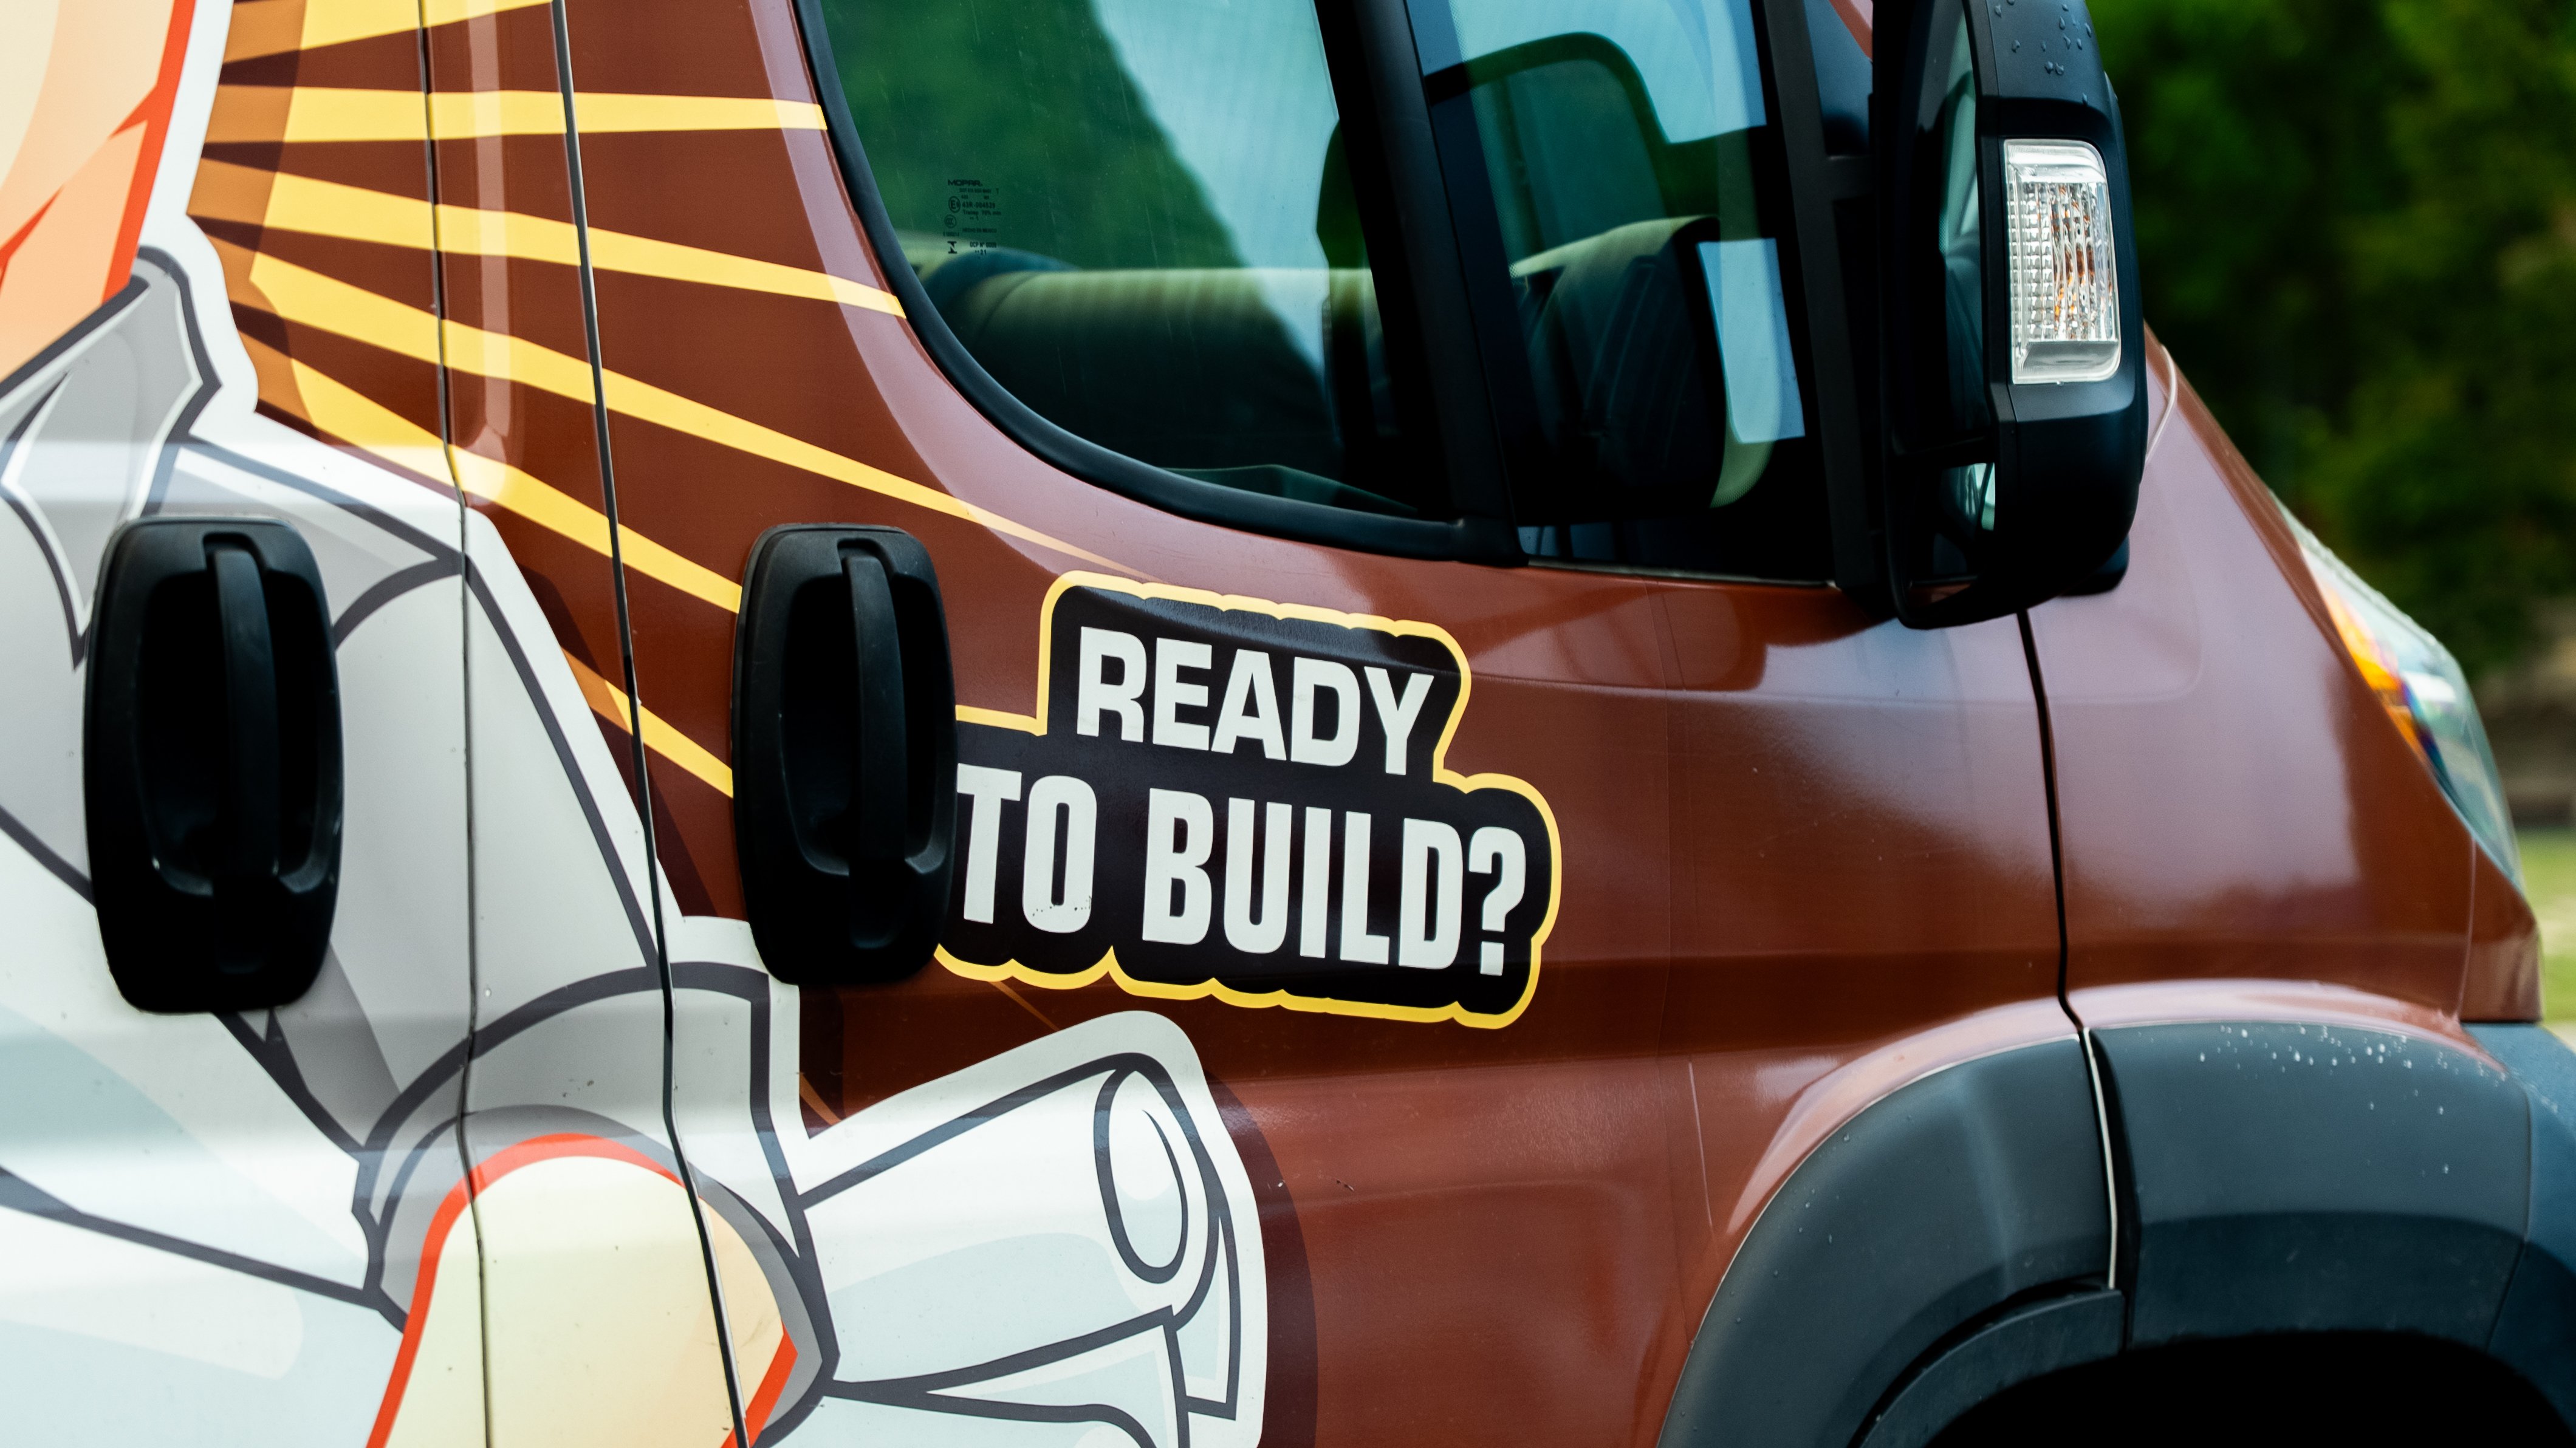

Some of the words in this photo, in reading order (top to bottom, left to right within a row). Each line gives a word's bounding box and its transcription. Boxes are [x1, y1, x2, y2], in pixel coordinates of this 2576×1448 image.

[1077, 626, 1434, 776] READY
[956, 763, 1097, 934] TO
[1142, 787, 1527, 977] BUILD?
